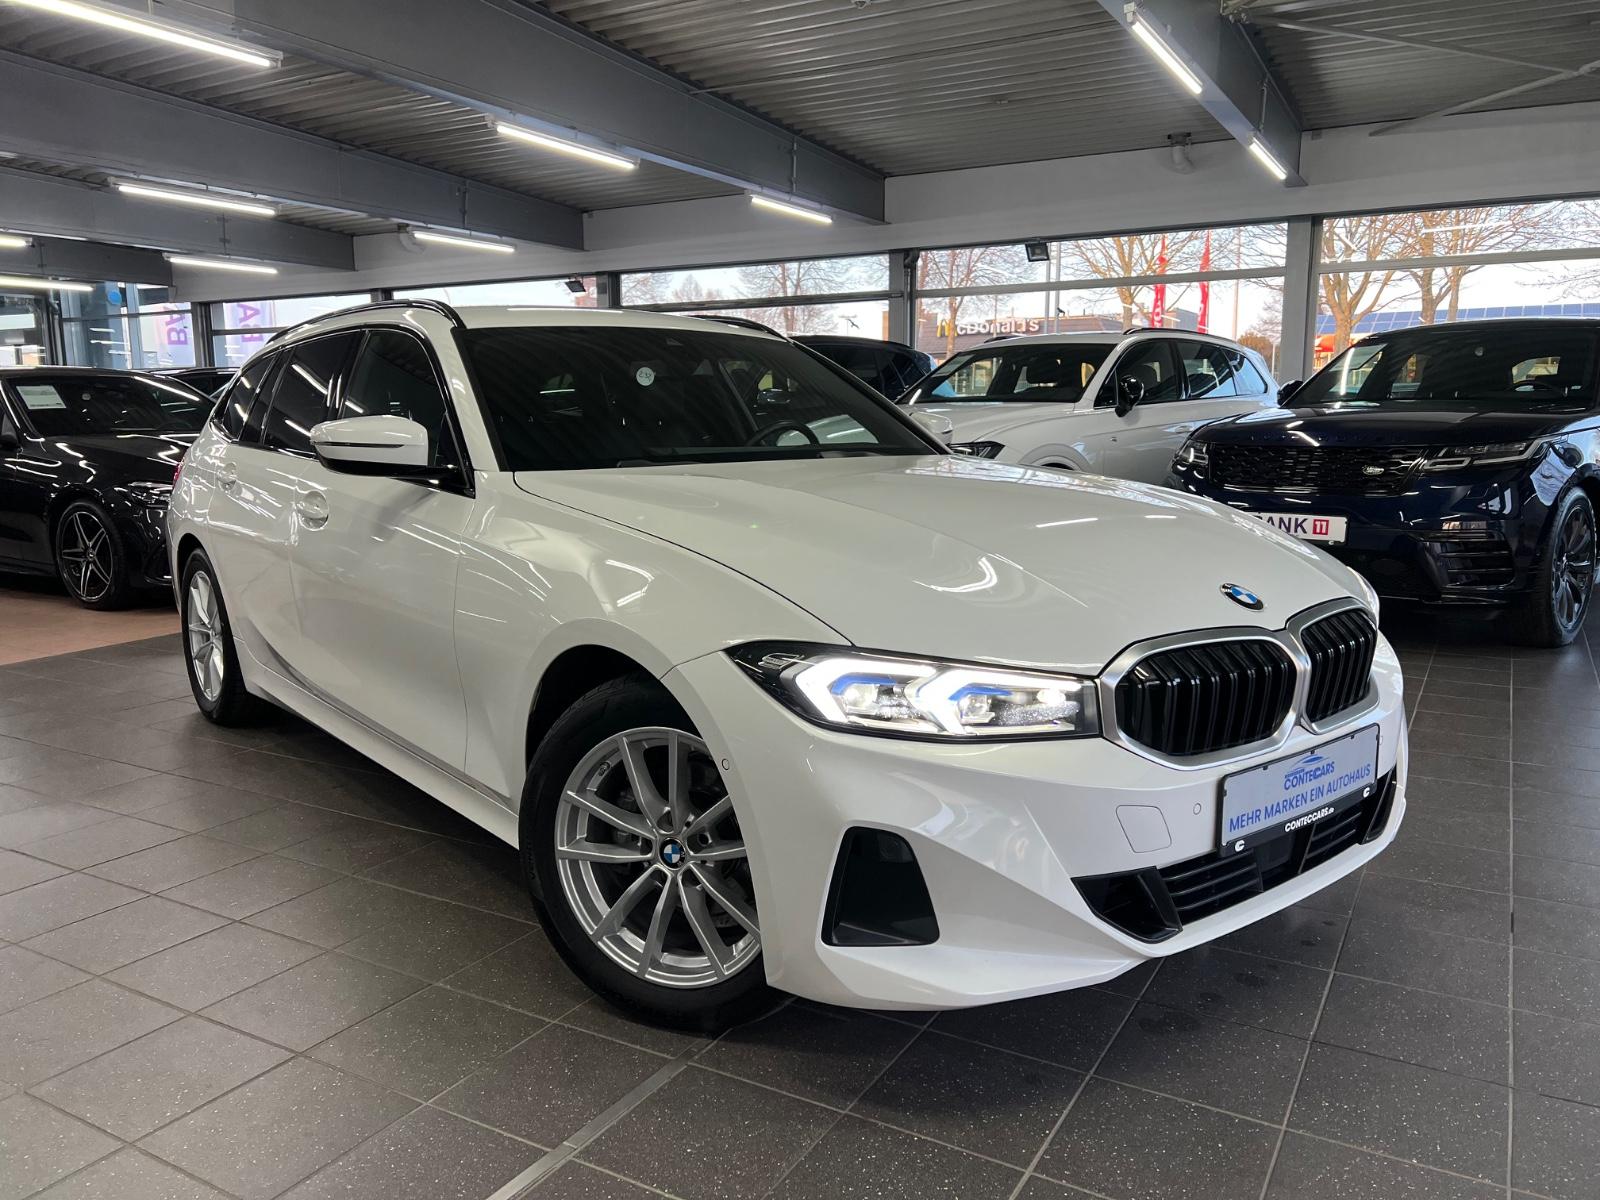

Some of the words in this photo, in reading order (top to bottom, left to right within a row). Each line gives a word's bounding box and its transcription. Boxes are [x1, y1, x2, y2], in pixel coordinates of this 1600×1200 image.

[1229, 808, 1261, 833] MEHR
[1264, 795, 1308, 820] MARKEN
[1310, 788, 1324, 805] EIN
[1326, 764, 1371, 797] AUTOHAUS
